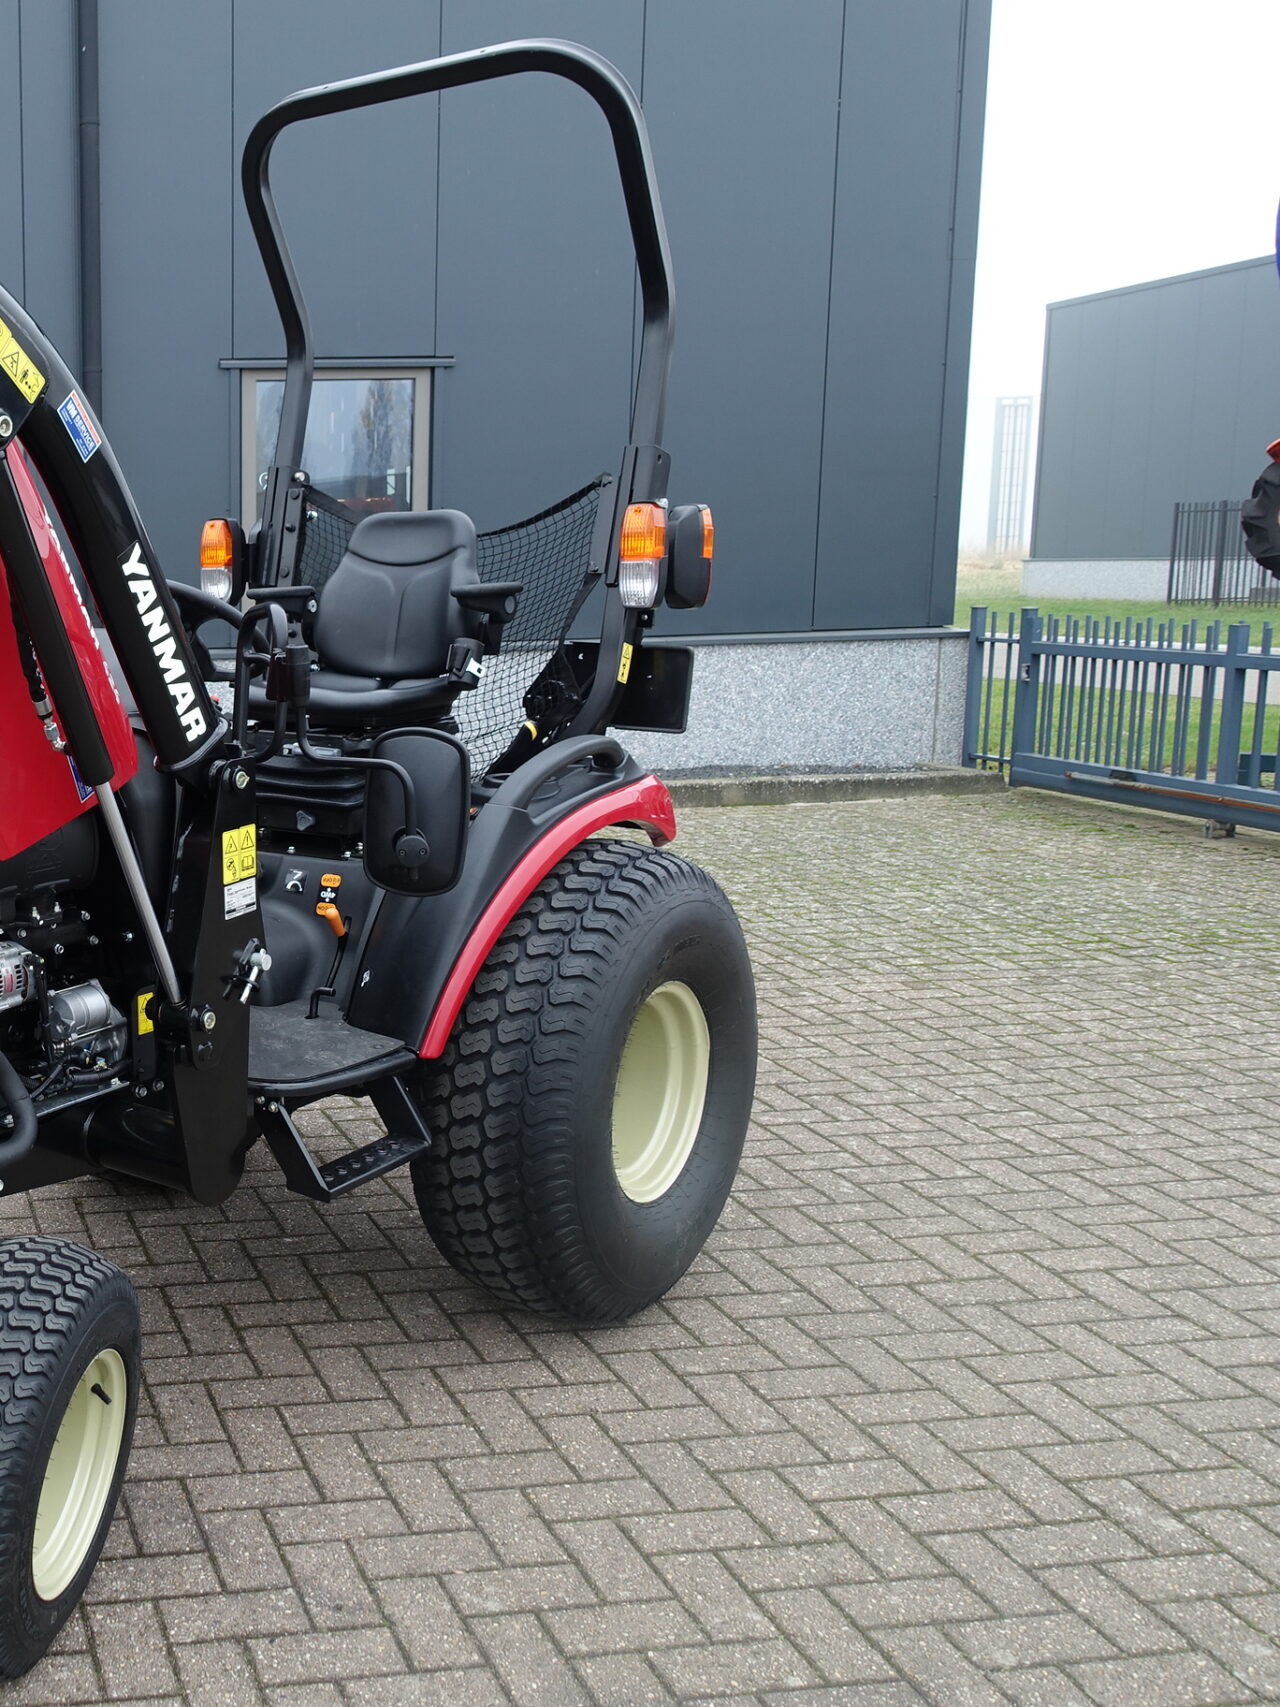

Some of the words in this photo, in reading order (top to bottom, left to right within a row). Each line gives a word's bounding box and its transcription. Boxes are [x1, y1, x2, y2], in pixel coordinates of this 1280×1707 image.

[73, 413, 96, 451] SERVICE
[42, 503, 100, 650] YANMAR
[121, 541, 207, 743] YANMAR
[320, 890, 336, 898] 4WD
